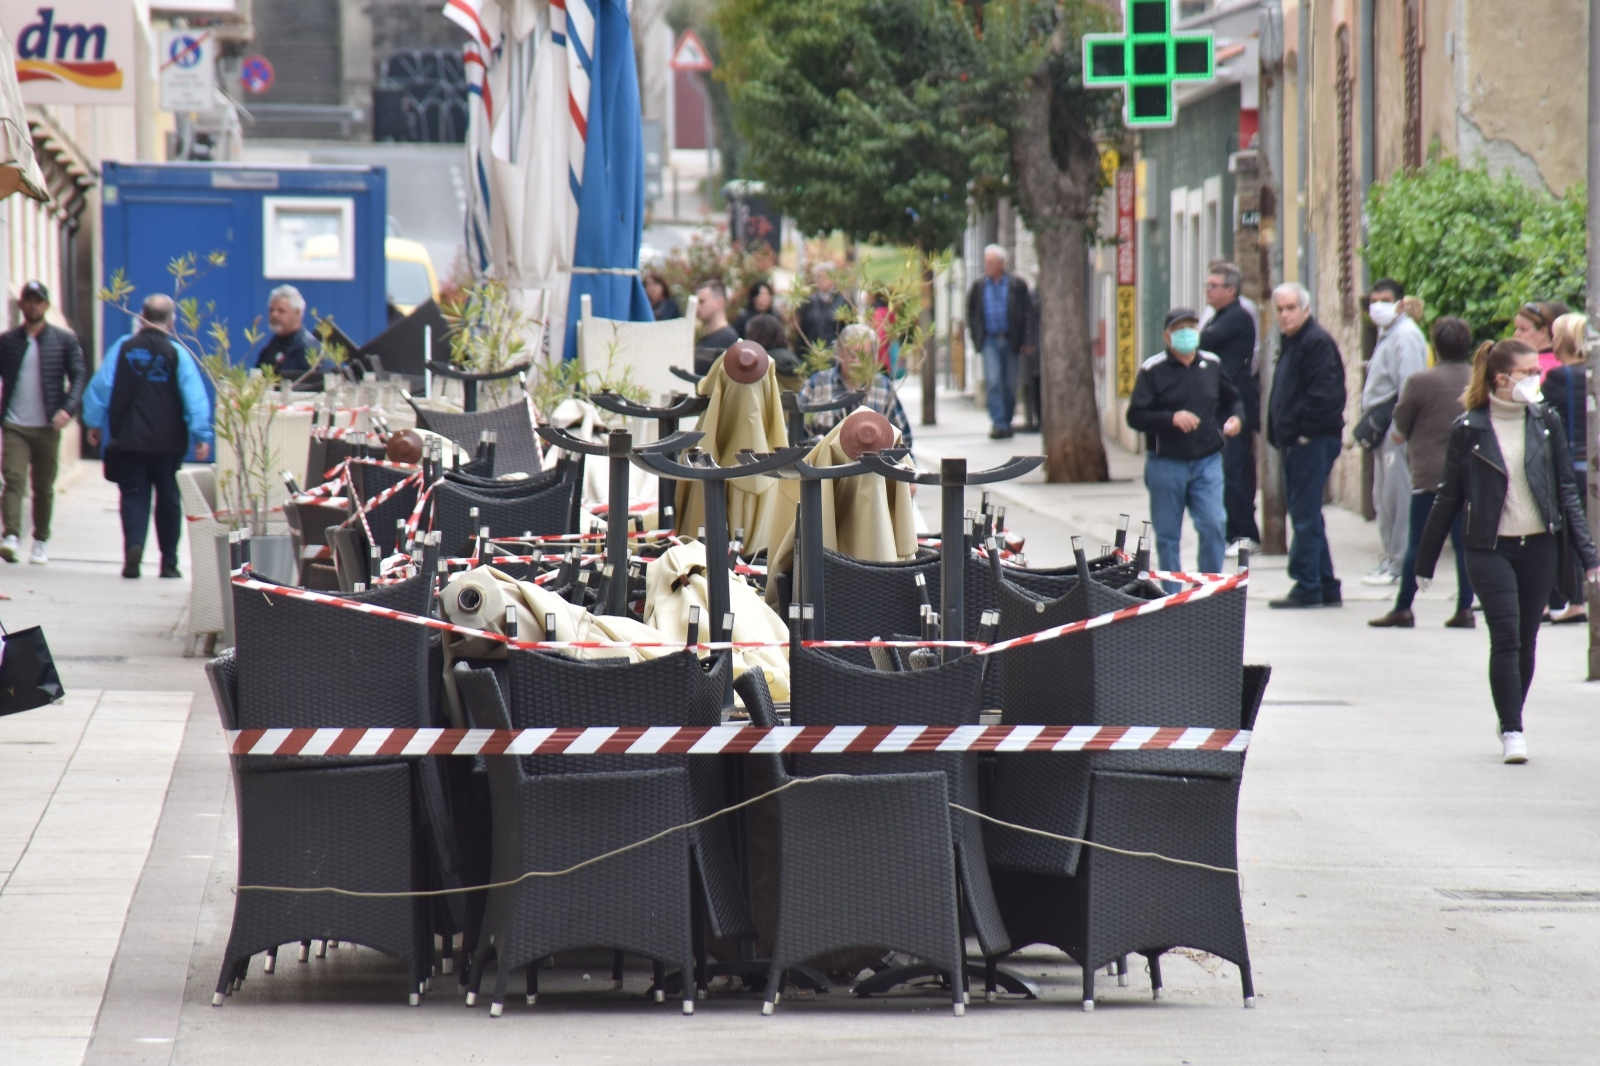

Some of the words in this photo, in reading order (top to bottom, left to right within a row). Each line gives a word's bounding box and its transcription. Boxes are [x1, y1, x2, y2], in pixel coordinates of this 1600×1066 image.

[16, 7, 108, 60] dm
[1118, 288, 1133, 341] OTKUP
[1118, 344, 1133, 398] ZLATA
